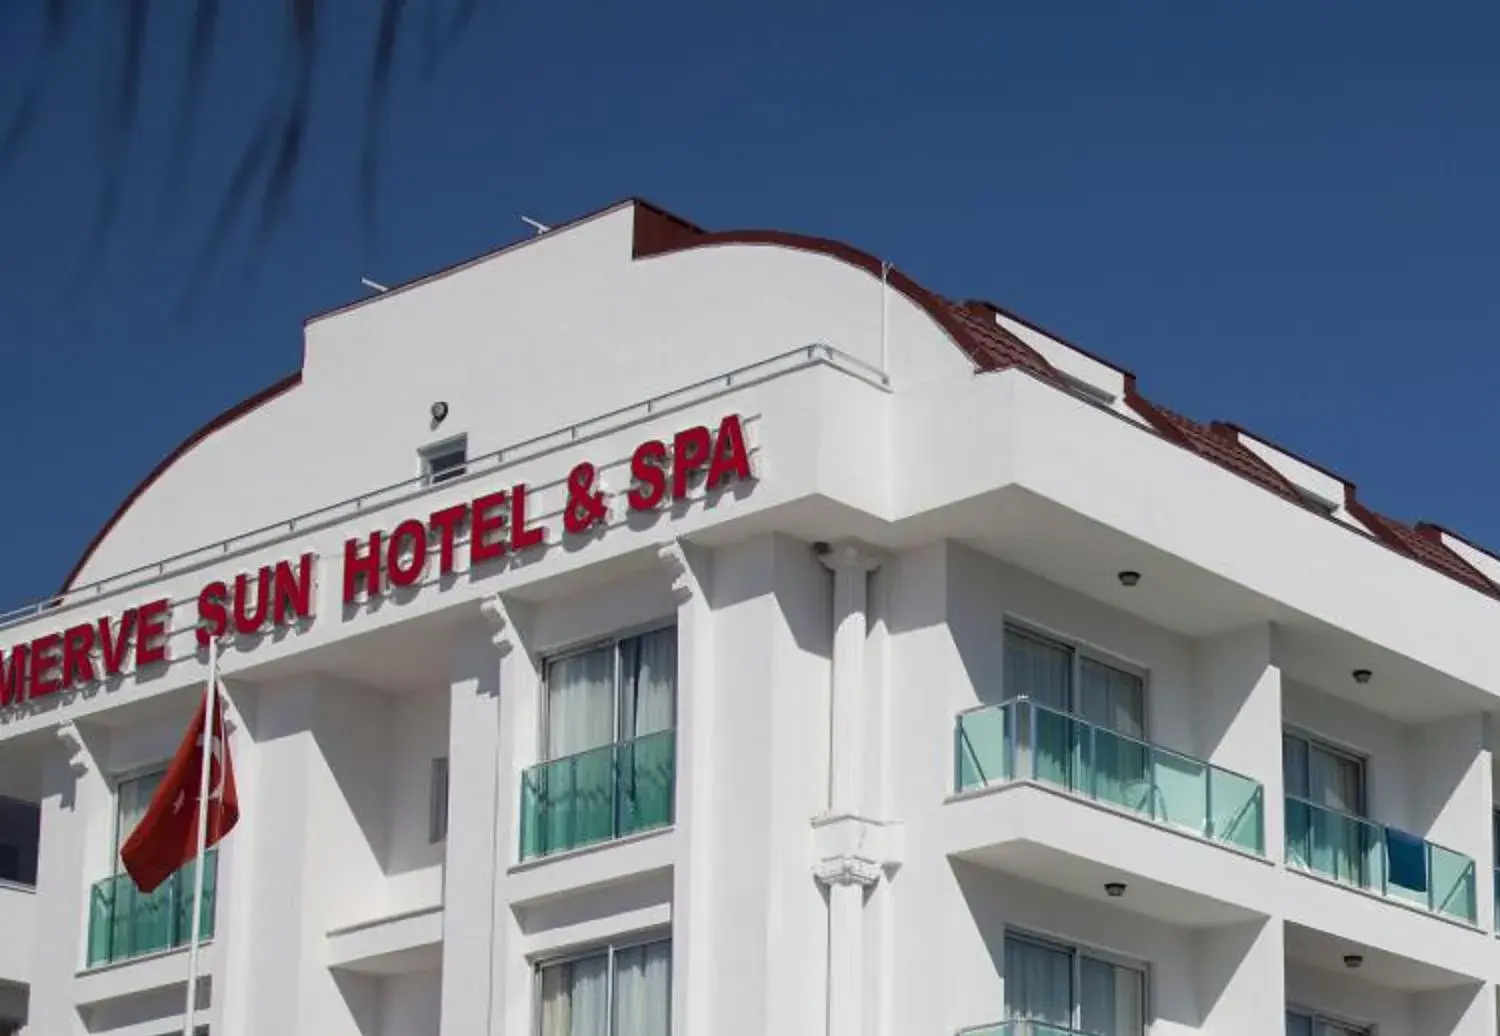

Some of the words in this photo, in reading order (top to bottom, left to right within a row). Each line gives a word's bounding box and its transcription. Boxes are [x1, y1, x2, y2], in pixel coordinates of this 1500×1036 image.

[0, 598, 170, 703] MERVE
[194, 553, 314, 645] SUN
[343, 484, 543, 604] HOTEL
[563, 462, 608, 534] &
[627, 414, 752, 511] SPA
